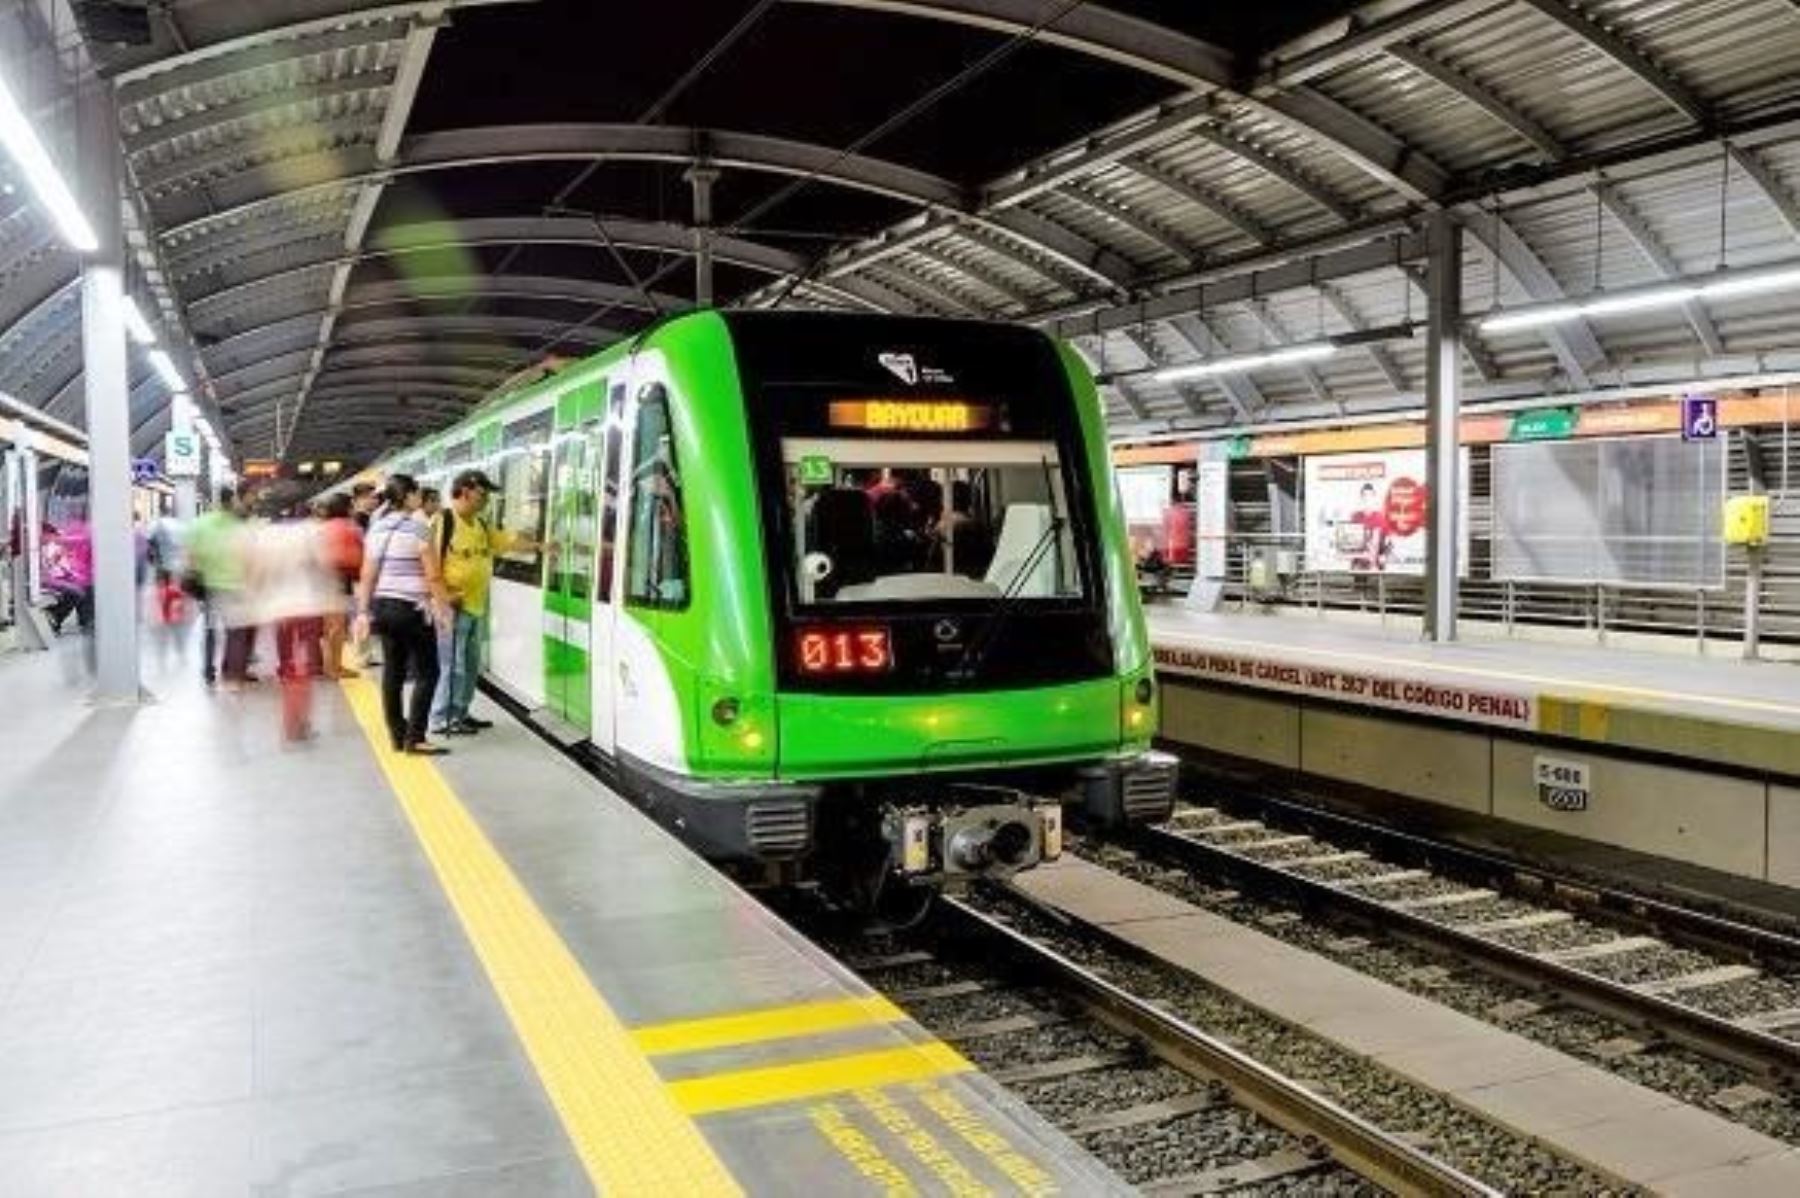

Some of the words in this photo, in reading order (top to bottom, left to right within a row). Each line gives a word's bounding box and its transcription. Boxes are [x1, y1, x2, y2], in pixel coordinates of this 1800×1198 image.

[174, 437, 192, 456] S
[802, 634, 884, 669] 013
[1372, 679, 1401, 700] DEL
